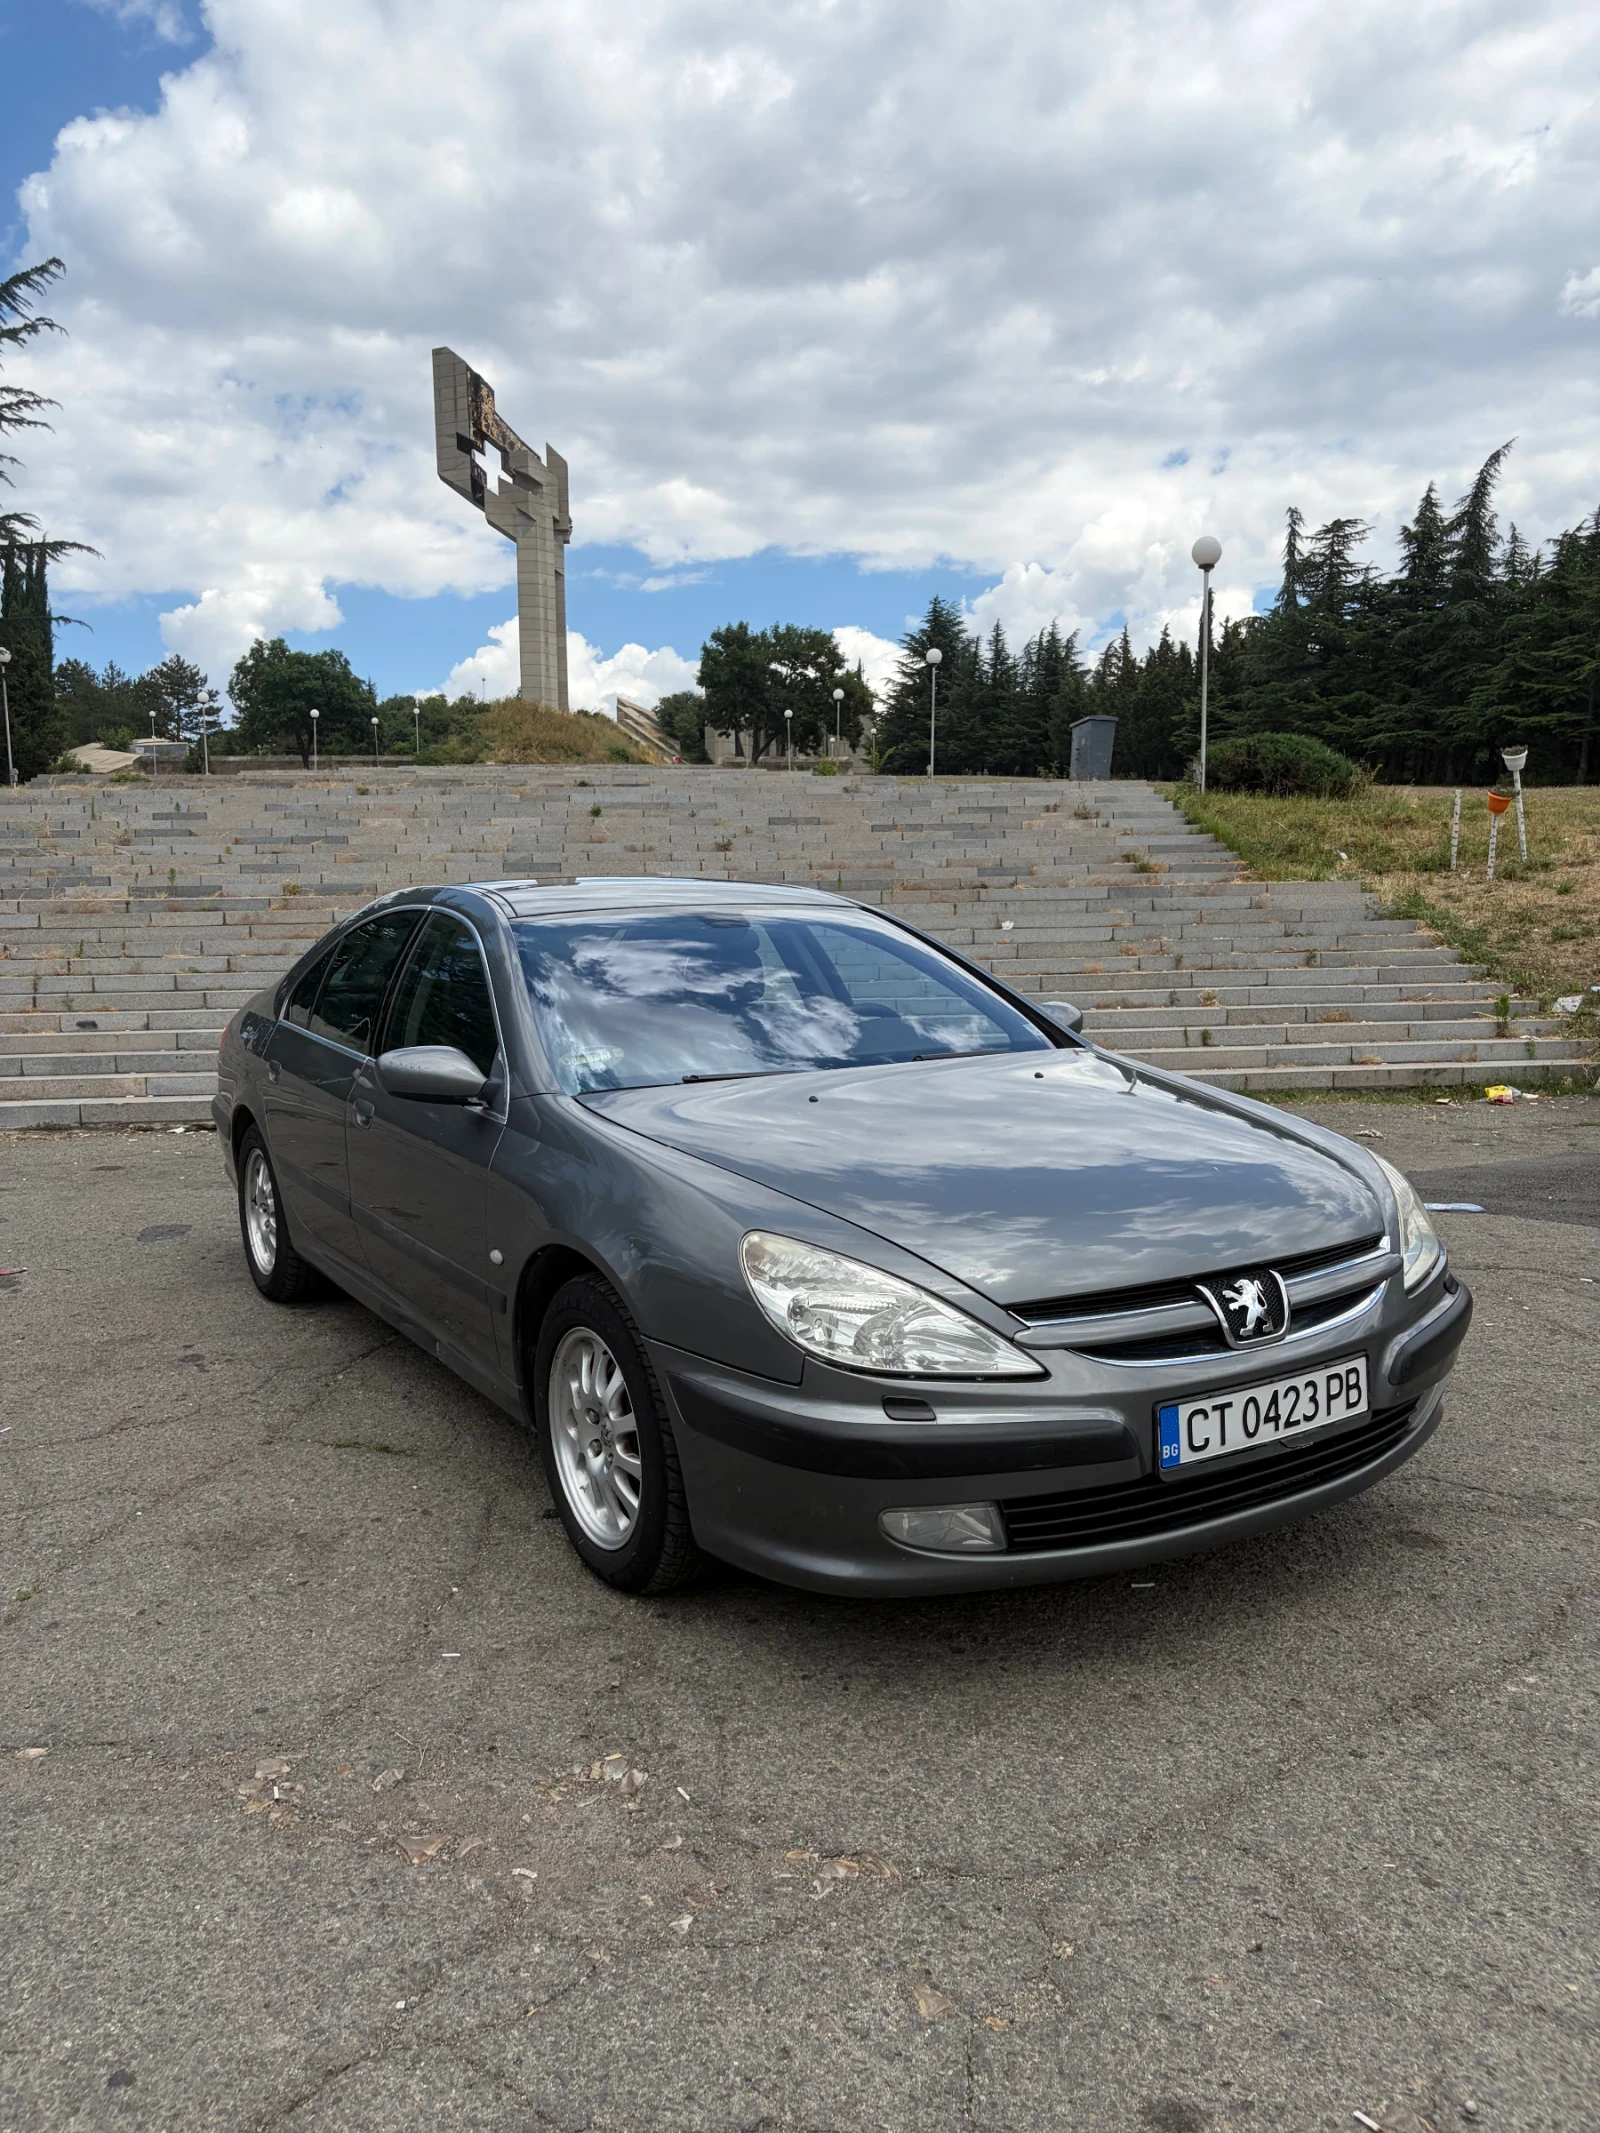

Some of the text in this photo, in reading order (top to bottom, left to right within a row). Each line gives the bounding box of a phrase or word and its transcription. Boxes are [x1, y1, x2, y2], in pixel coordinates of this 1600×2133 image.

[1187, 1366, 1362, 1453] CT 0423 PB
[1162, 1443, 1179, 1459] BG
